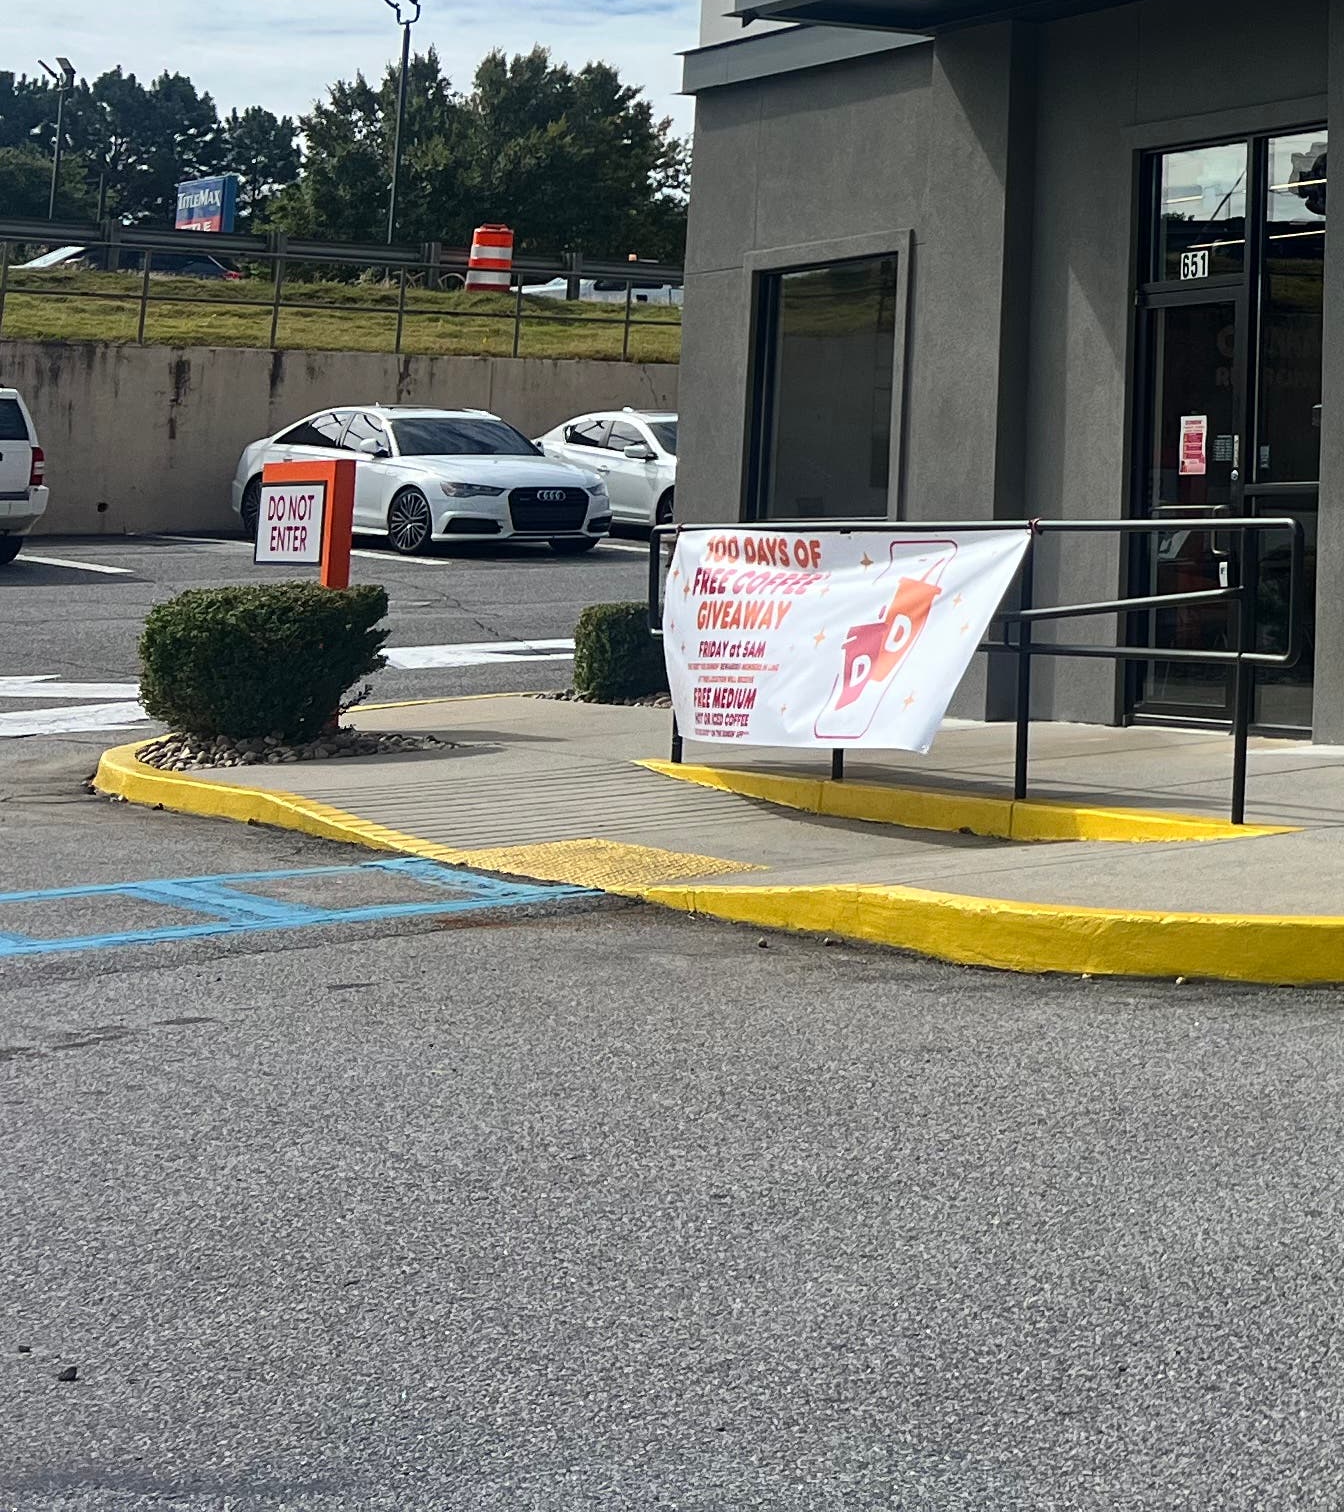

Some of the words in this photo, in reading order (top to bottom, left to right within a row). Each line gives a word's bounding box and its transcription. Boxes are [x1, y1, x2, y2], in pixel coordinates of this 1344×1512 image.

[1182, 252, 1206, 279] 651
[268, 495, 285, 521] DO
[288, 494, 315, 521] NOT
[269, 525, 307, 552] ENTER
[705, 536, 740, 564] 100
[743, 536, 790, 567] DAYS
[794, 538, 822, 569] OF
[692, 567, 738, 597] FREE
[696, 600, 793, 631] GIVEAWAY
[884, 613, 912, 653] D
[699, 640, 729, 658] FRIDAY
[849, 654, 872, 687] D
[693, 687, 711, 708] FREE
[712, 687, 757, 709] MEDIUM
[725, 713, 750, 727] COFFEE
